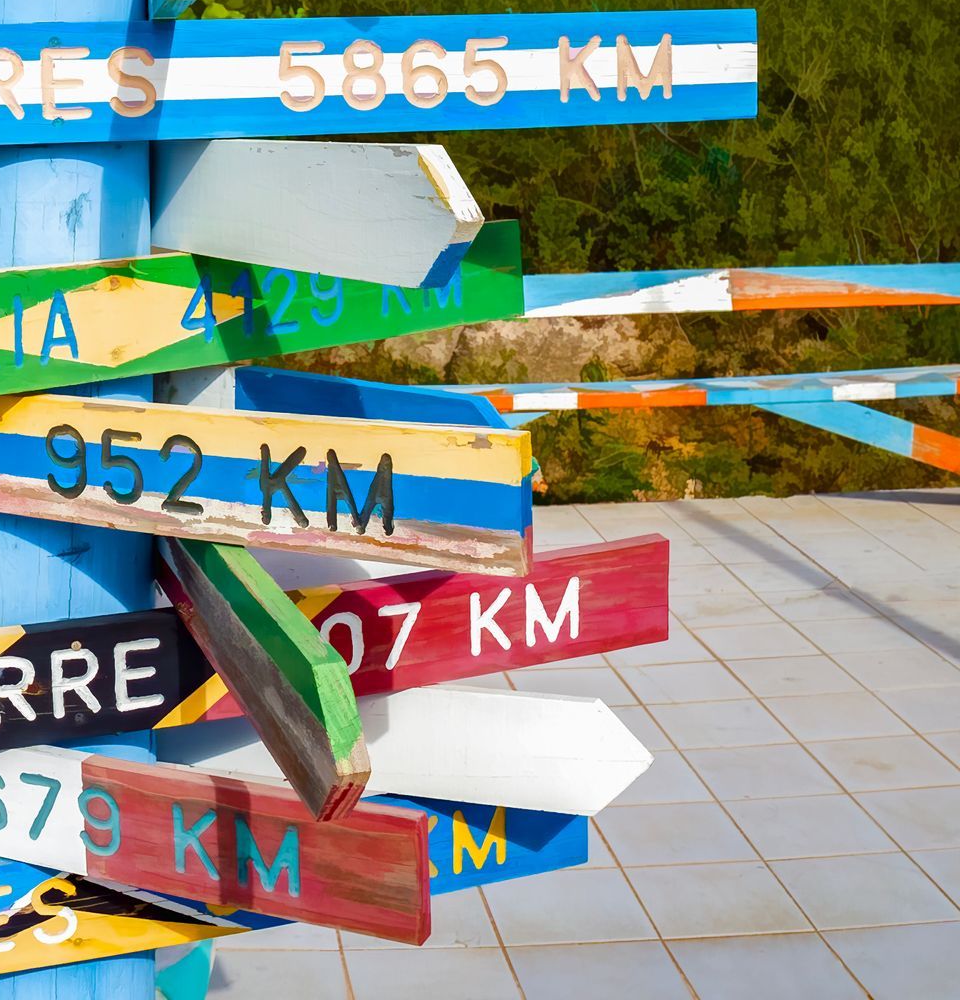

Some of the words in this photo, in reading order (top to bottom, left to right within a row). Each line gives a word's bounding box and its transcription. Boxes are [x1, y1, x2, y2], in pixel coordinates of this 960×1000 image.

[279, 36, 509, 113] 5865
[558, 34, 673, 103] KM
[181, 267, 344, 344] 4129
[46, 423, 205, 516] 952
[259, 443, 395, 537] KM
[470, 576, 580, 657] KM
[172, 803, 300, 898] KM
[428, 805, 506, 878] M
